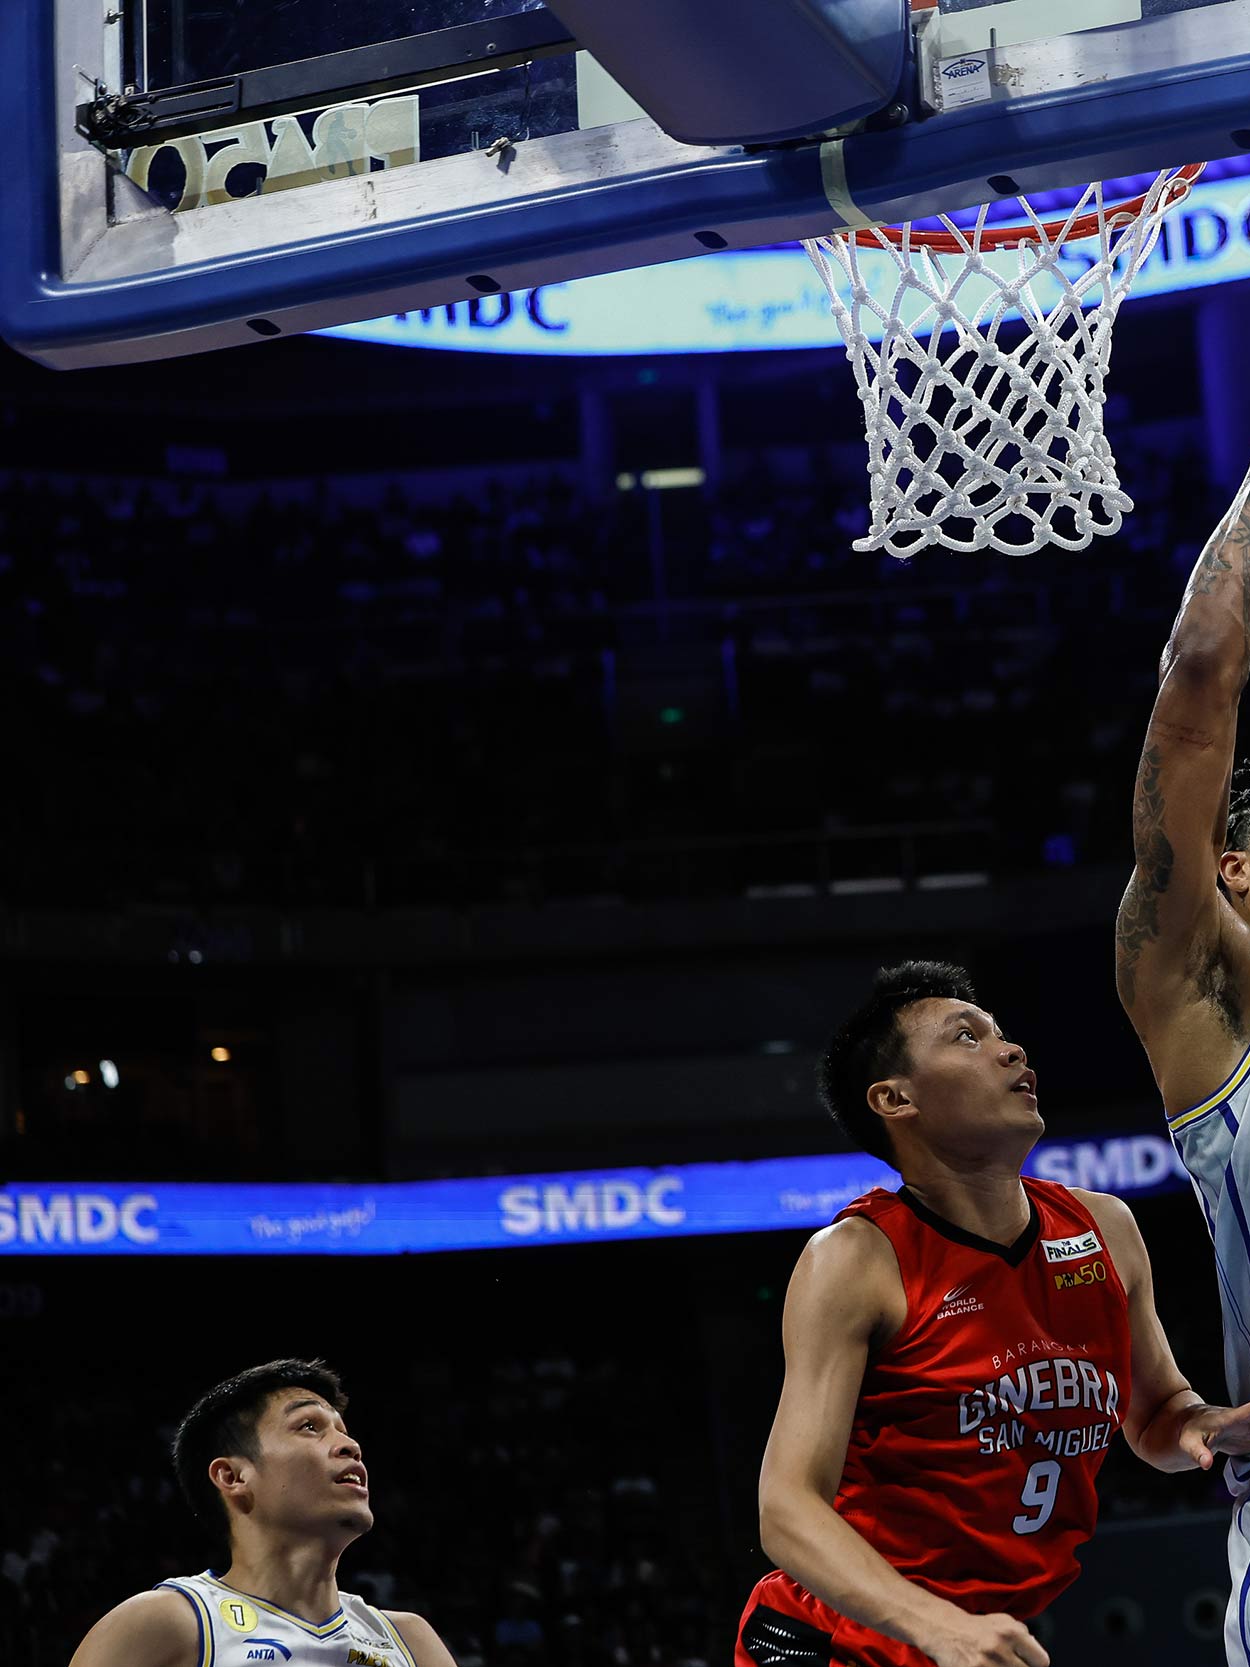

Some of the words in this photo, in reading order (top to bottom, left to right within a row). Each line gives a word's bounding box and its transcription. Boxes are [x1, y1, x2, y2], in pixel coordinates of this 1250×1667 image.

[948, 64, 980, 80] ARENA
[501, 1175, 686, 1236] SMDC
[1046, 1238, 1097, 1260] FINALS
[936, 1303, 985, 1320] BALANCE
[942, 1297, 976, 1311] WORLD
[958, 1358, 1120, 1435] GINEBRA
[978, 1419, 1025, 1455] SAN
[1034, 1422, 1111, 1457] MIGUEL
[1012, 1460, 1062, 1535] 9
[229, 1604, 246, 1627] 1
[246, 1648, 275, 1661] ANTA
